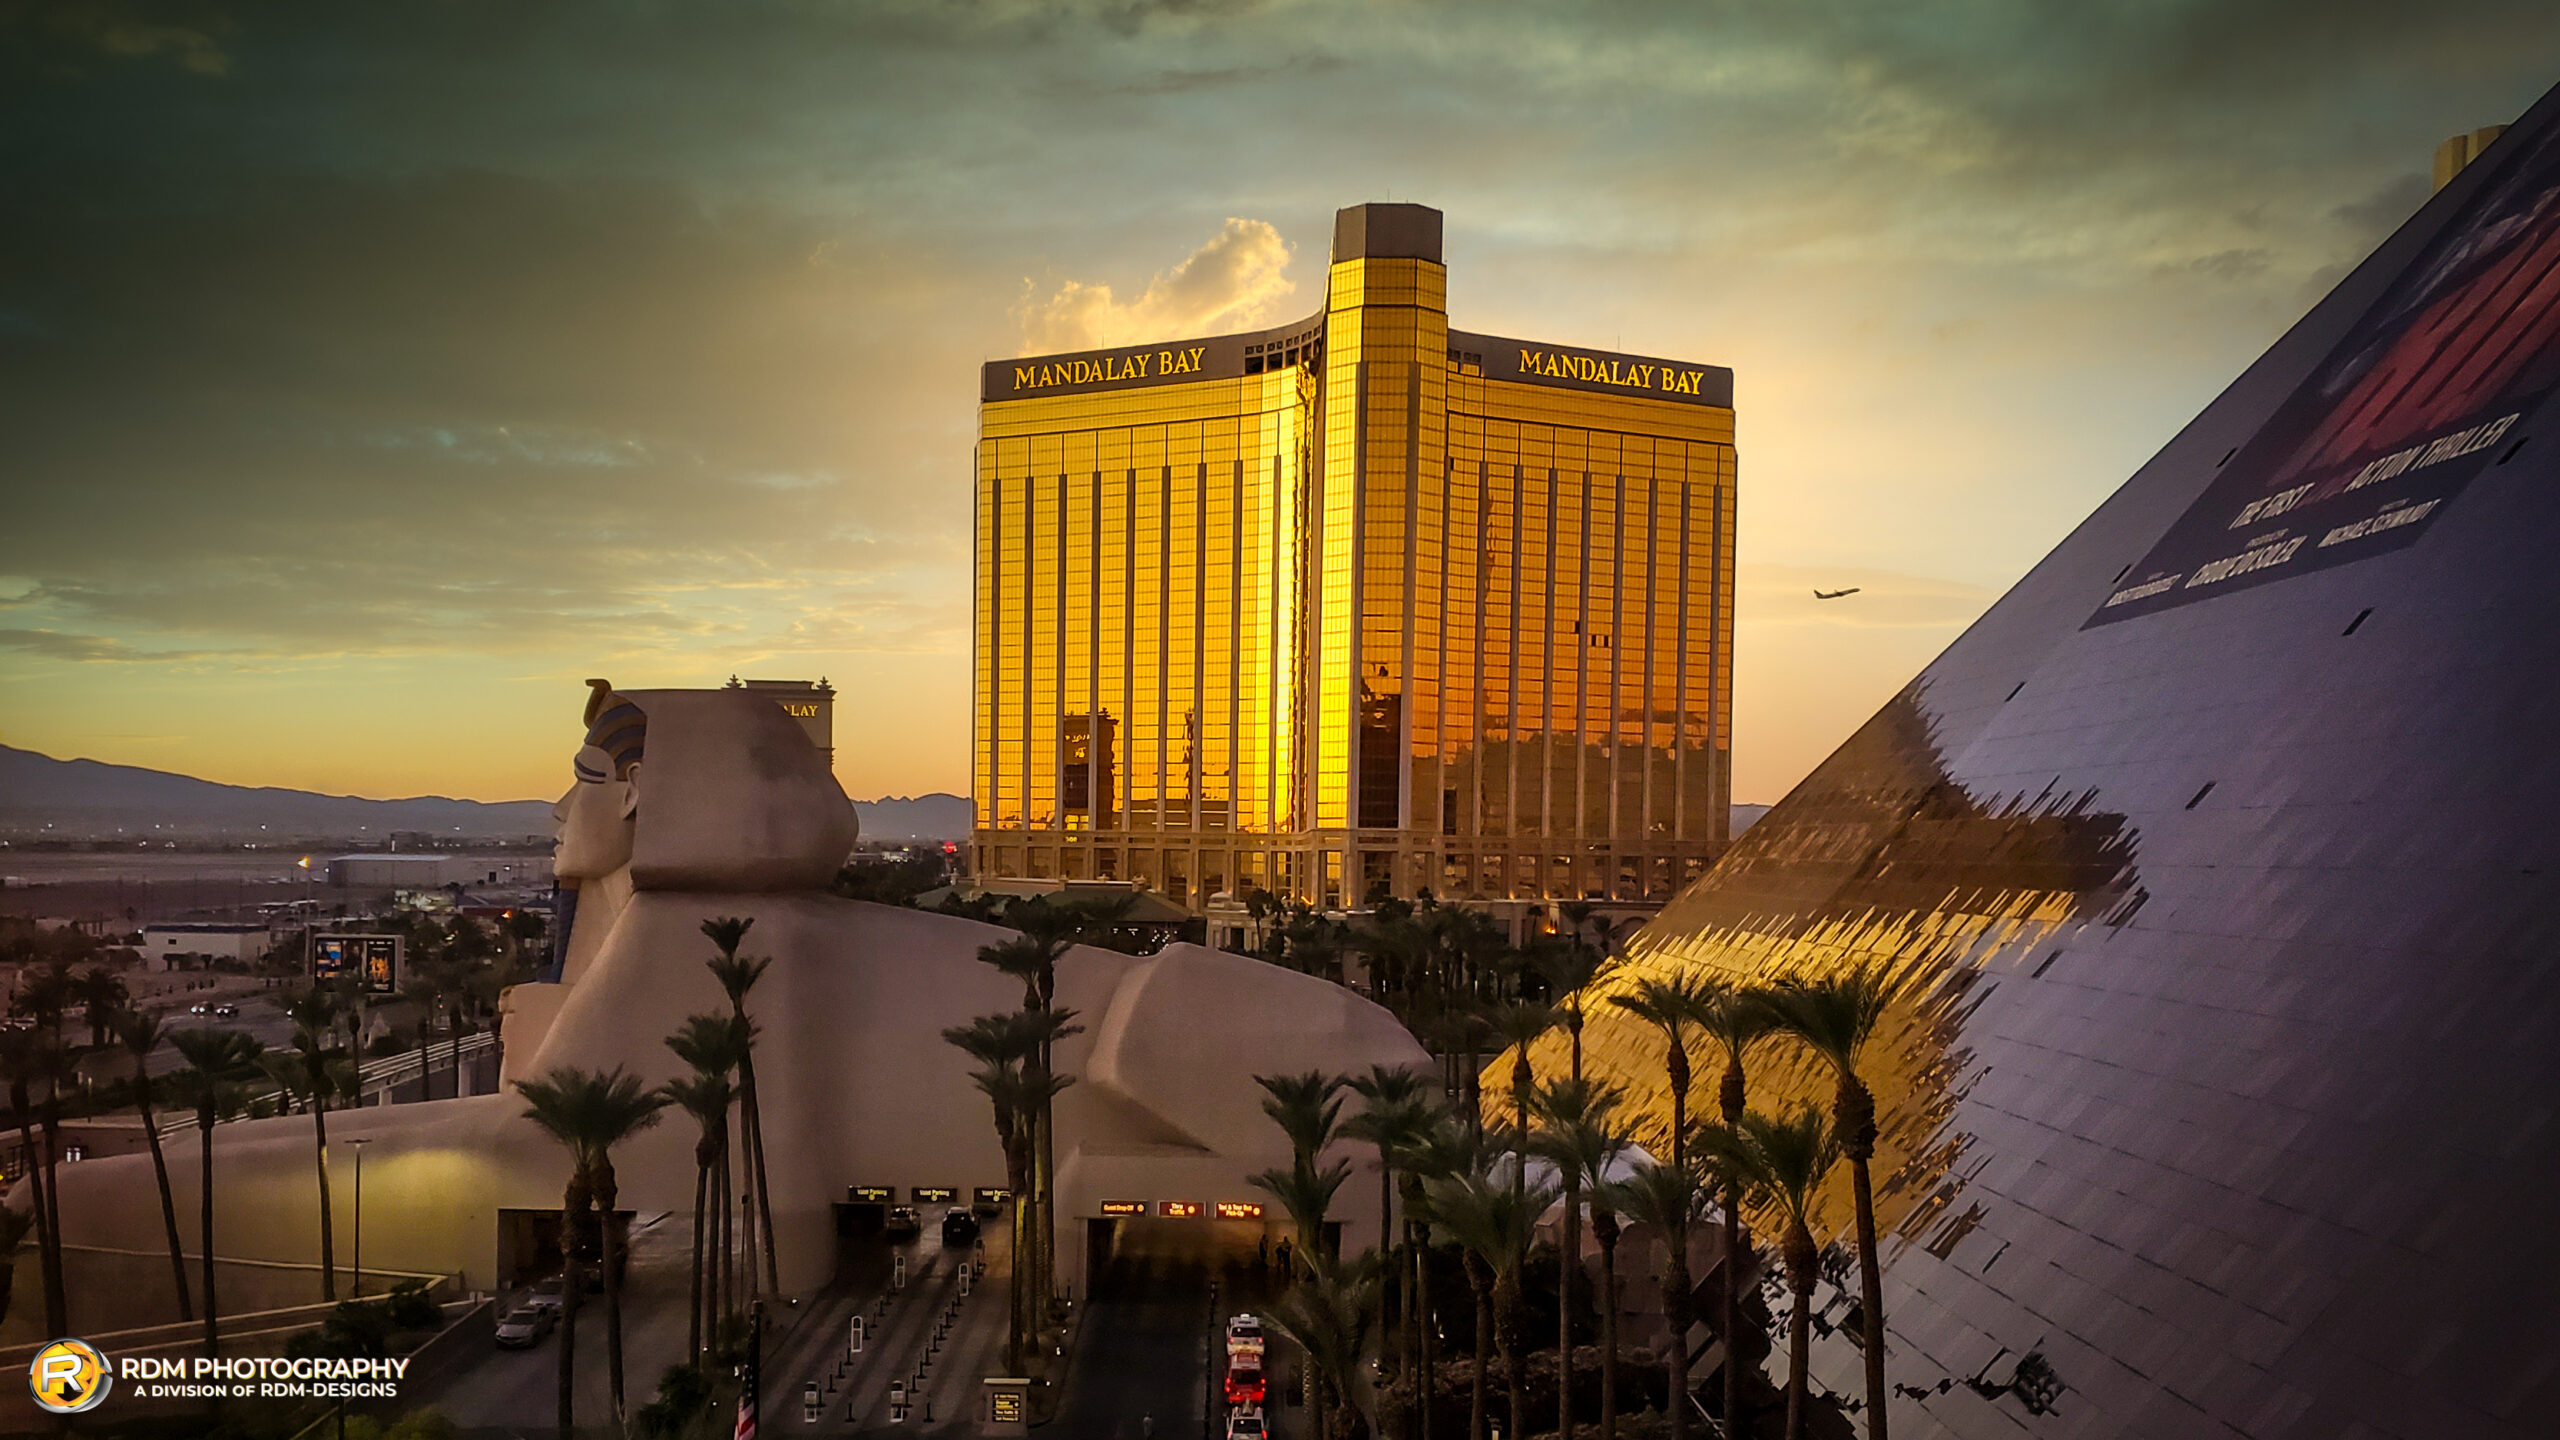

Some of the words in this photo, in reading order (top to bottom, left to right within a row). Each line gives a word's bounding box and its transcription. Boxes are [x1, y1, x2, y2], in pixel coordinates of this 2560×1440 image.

[1013, 352, 1152, 391] MANDALAY
[1158, 347, 1206, 376] BAY
[1518, 349, 1656, 389] MANDALAY
[1660, 366, 1705, 396] BAY
[2254, 481, 2316, 523] FIRST
[2343, 443, 2427, 494] ACTION
[2409, 412, 2521, 472] THRILLER
